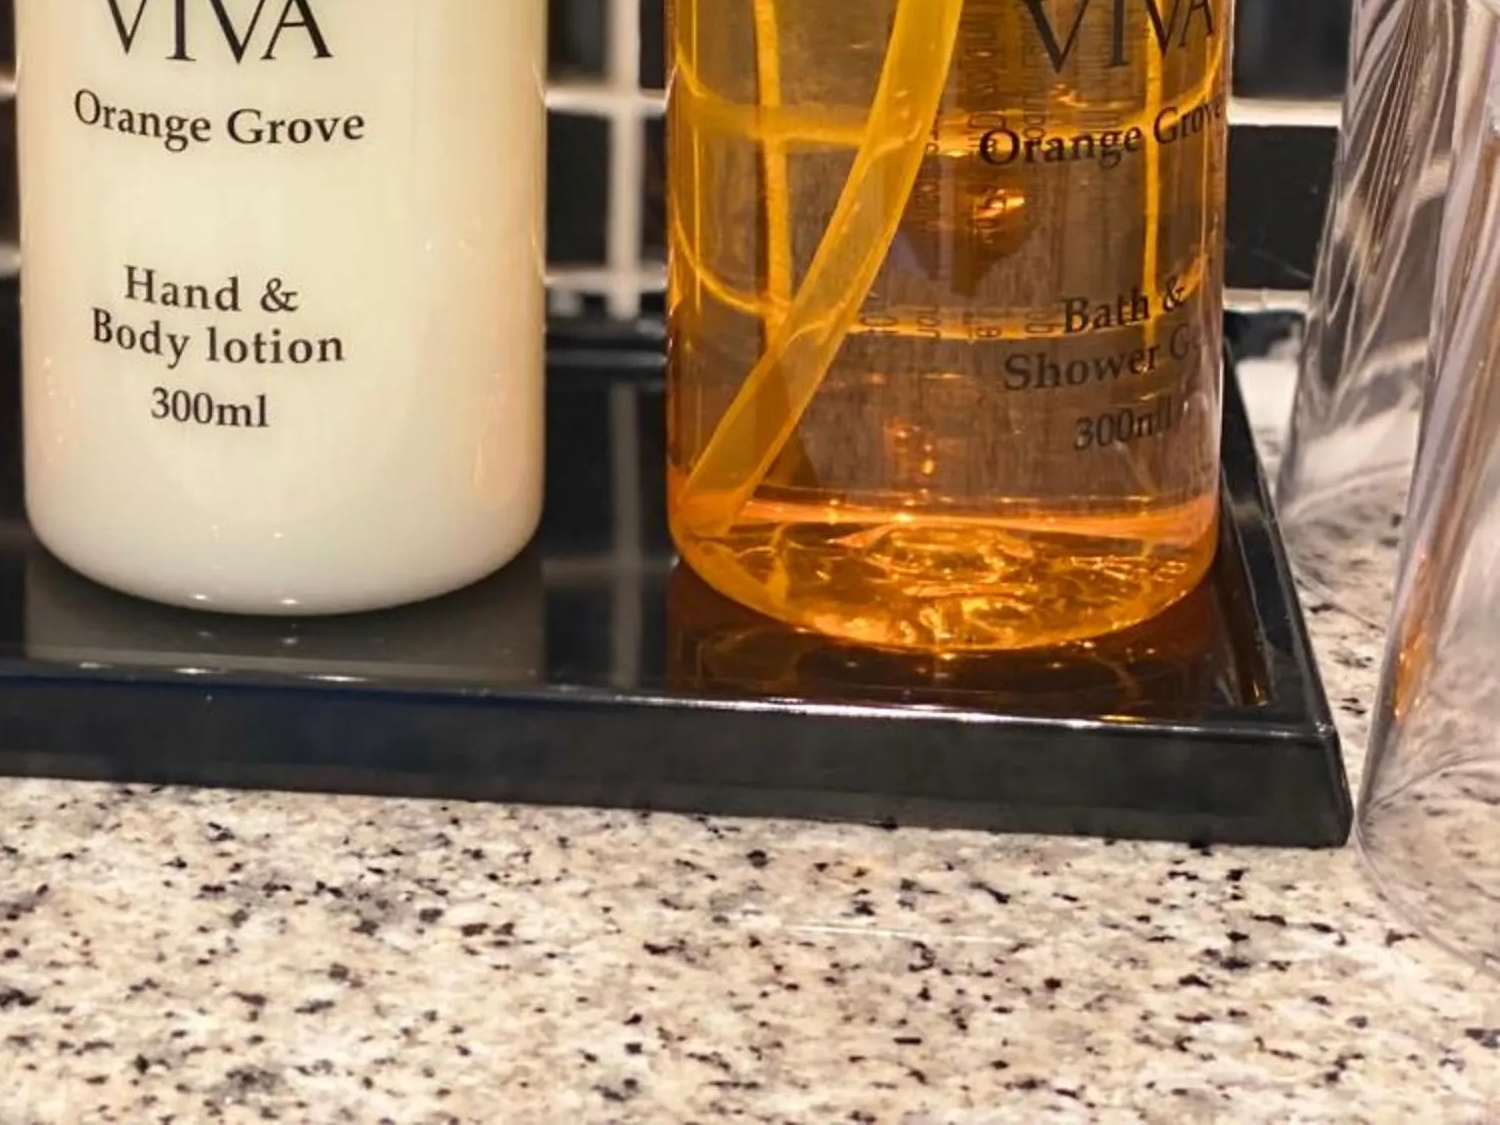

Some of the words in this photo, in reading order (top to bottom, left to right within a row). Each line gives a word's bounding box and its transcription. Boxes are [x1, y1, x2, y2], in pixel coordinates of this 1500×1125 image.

[74, 89, 212, 152] Orange
[226, 107, 366, 145] Grove
[979, 124, 1142, 170] Orange
[122, 264, 242, 313] Hand
[260, 277, 299, 314] &
[1061, 286, 1151, 333] Bath
[1162, 276, 1186, 312] &
[92, 308, 191, 369] Body
[207, 326, 345, 364] lotion
[1003, 343, 1161, 392] Shower
[150, 387, 270, 428] 300ml
